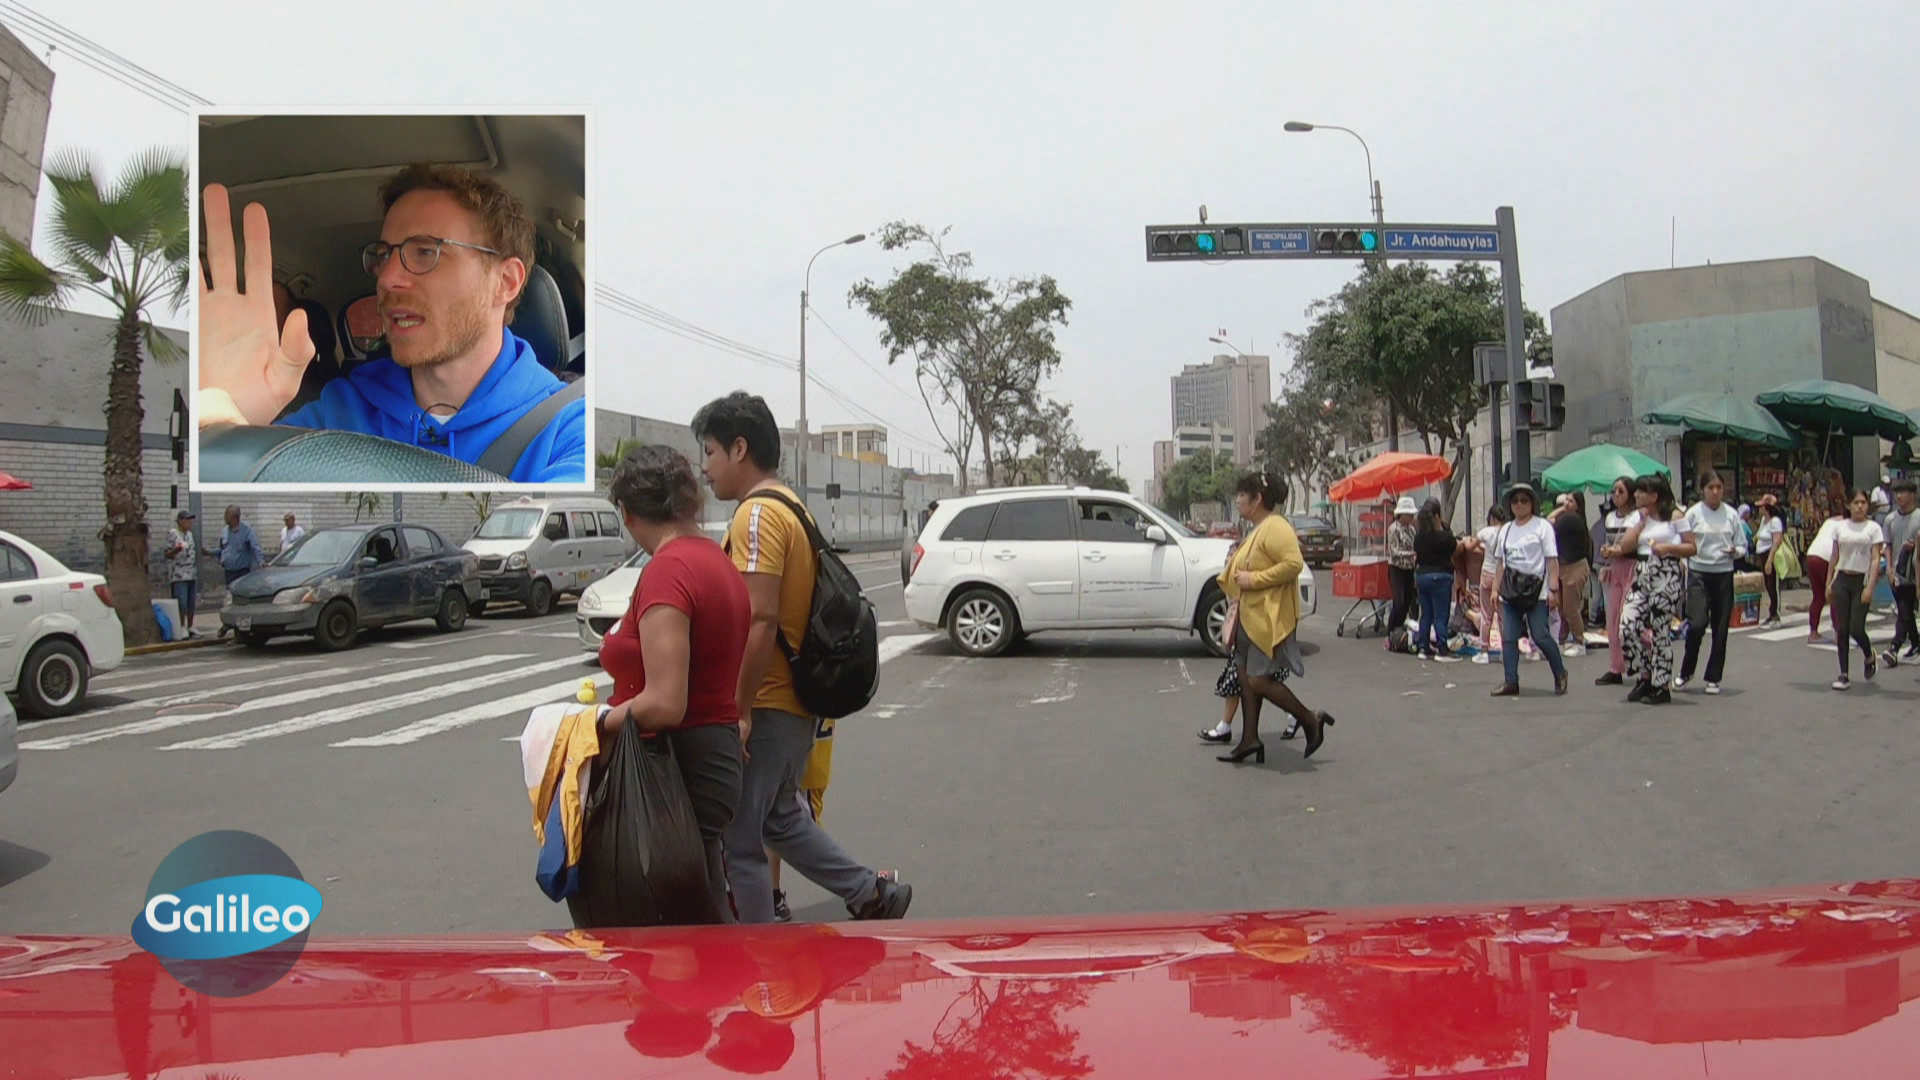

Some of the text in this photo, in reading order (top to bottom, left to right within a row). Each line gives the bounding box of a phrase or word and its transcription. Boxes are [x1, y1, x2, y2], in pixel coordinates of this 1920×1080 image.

[1255, 232, 1303, 240] MUNICIPALIDAD
[1262, 241, 1297, 249] DE LIMA
[1391, 233, 1493, 250] Jr. Andahuaylas
